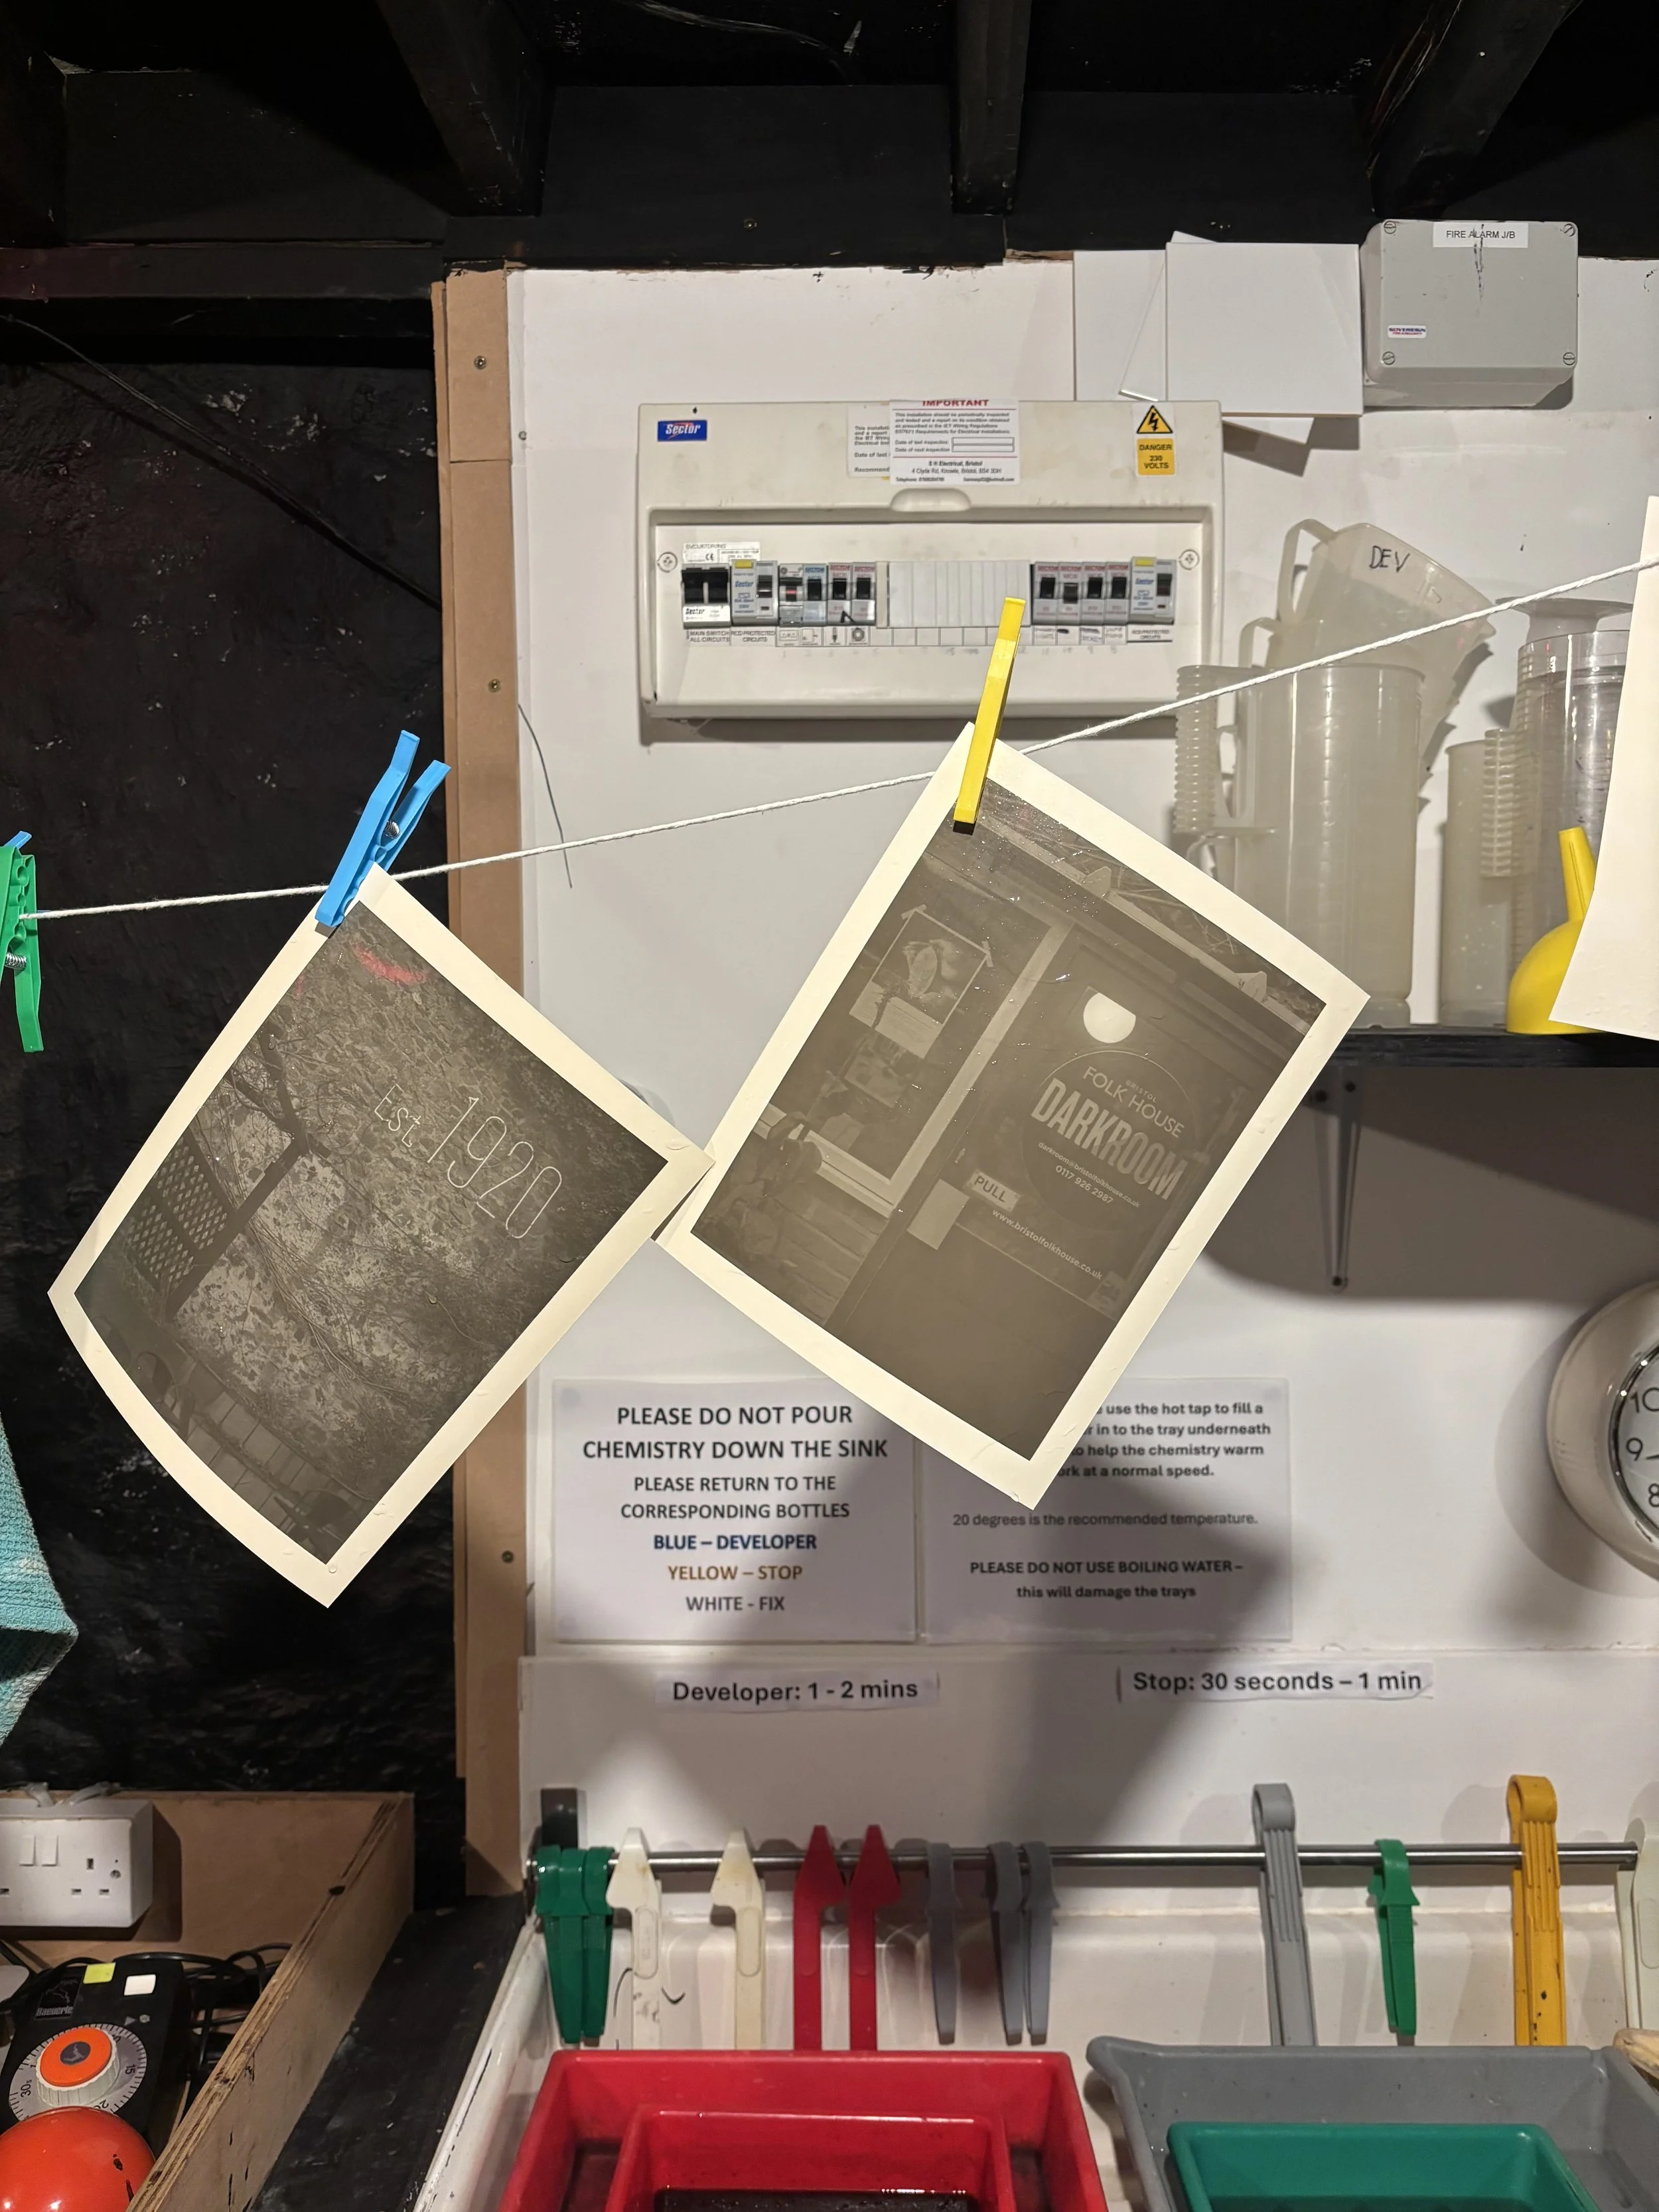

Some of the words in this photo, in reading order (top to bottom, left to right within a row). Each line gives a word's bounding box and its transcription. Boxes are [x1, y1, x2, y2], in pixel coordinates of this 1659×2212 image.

[666, 423, 701, 435] Sector
[1369, 545, 1411, 573] DEV
[1125, 1079, 1157, 1103] BRISTOL
[1083, 1066, 1127, 1103] FOLK
[1128, 1094, 1185, 1138] HOUSE
[1031, 1078, 1188, 1200] DARKROOM
[427, 1096, 562, 1238] 1920
[1038, 1142, 1141, 1208] darkroom@bristolfolkhouse.co.uk
[974, 1175, 1006, 1203] PULL
[1055, 1165, 1075, 1181] 0117
[1074, 1177, 1092, 1191] 926
[1092, 1187, 1114, 1204] 2987
[992, 1209, 1102, 1280] www.bristolfolkhouse.co.uk
[1106, 1405, 1131, 1415] use
[1135, 1403, 1157, 1415] the
[1162, 1403, 1185, 1415] hot
[1189, 1404, 1212, 1417] tap
[1215, 1404, 1228, 1414] to
[1232, 1402, 1252, 1414] fill
[1255, 1405, 1263, 1414] a
[1630, 1387, 1659, 1413] 10
[617, 1407, 692, 1425] PLEASE
[699, 1407, 731, 1425] DO
[739, 1406, 785, 1424] NOT
[792, 1406, 853, 1424] POUR
[1097, 1424, 1110, 1435] in
[1113, 1425, 1127, 1435] to
[1131, 1424, 1153, 1435] the
[1157, 1424, 1184, 1438] tray
[1188, 1424, 1271, 1436] underneath
[583, 1441, 705, 1459] CHEMISTRY
[712, 1440, 784, 1459] DOWN
[790, 1440, 831, 1458] THE
[837, 1439, 888, 1457] SINK
[1088, 1444, 1118, 1458] help
[1122, 1445, 1145, 1456] the
[1149, 1444, 1220, 1458] chemistry
[1223, 1446, 1264, 1456] warm
[1626, 1437, 1643, 1461] 9
[1057, 1465, 1080, 1477] ork
[1083, 1467, 1098, 1477] at
[1100, 1468, 1108, 1477] a
[1112, 1465, 1163, 1477] normal
[1166, 1465, 1214, 1479] speed.
[634, 1477, 694, 1491] PLEASE
[699, 1477, 769, 1491] RETURN
[774, 1477, 798, 1491] TO
[803, 1476, 836, 1490] THE
[1648, 1483, 1659, 1507] 8
[620, 1504, 770, 1519] CORRESPONDING
[776, 1503, 850, 1518] BOTTLES
[953, 1514, 969, 1526] 20
[973, 1514, 1026, 1528] degrees
[1029, 1514, 1040, 1525] is
[1043, 1514, 1065, 1525] the
[1068, 1513, 1167, 1525] recommended
[1171, 1513, 1258, 1527] temperature.
[654, 1535, 697, 1550] BLUE
[717, 1534, 817, 1550] DEVELOPER
[668, 1566, 738, 1580] YELLOW
[757, 1566, 803, 1580] STOP
[970, 1562, 1023, 1574] PLEASE
[1027, 1562, 1049, 1574] DO
[1053, 1562, 1082, 1574] NOT
[1086, 1562, 1115, 1574] USE
[1119, 1561, 1179, 1574] BOILING
[1183, 1561, 1232, 1573] WATER
[1017, 1586, 1043, 1598] this
[1046, 1586, 1072, 1597] will
[1075, 1586, 1131, 1600] damage
[1135, 1586, 1157, 1597] the
[1161, 1587, 1196, 1599] trays
[686, 1597, 743, 1611] WHITE
[759, 1597, 785, 1611] FIX
[674, 1682, 800, 1705] Developer:
[808, 1682, 818, 1699] 1
[841, 1680, 854, 1699] 2
[862, 1680, 918, 1698] mins
[1133, 1672, 1194, 1695] Stop:
[1202, 1672, 1228, 1690] 30
[1234, 1671, 1334, 1690] seconds
[1358, 1672, 1369, 1689] 1
[1378, 1671, 1422, 1690] min
[125, 2064, 135, 2075] 15
